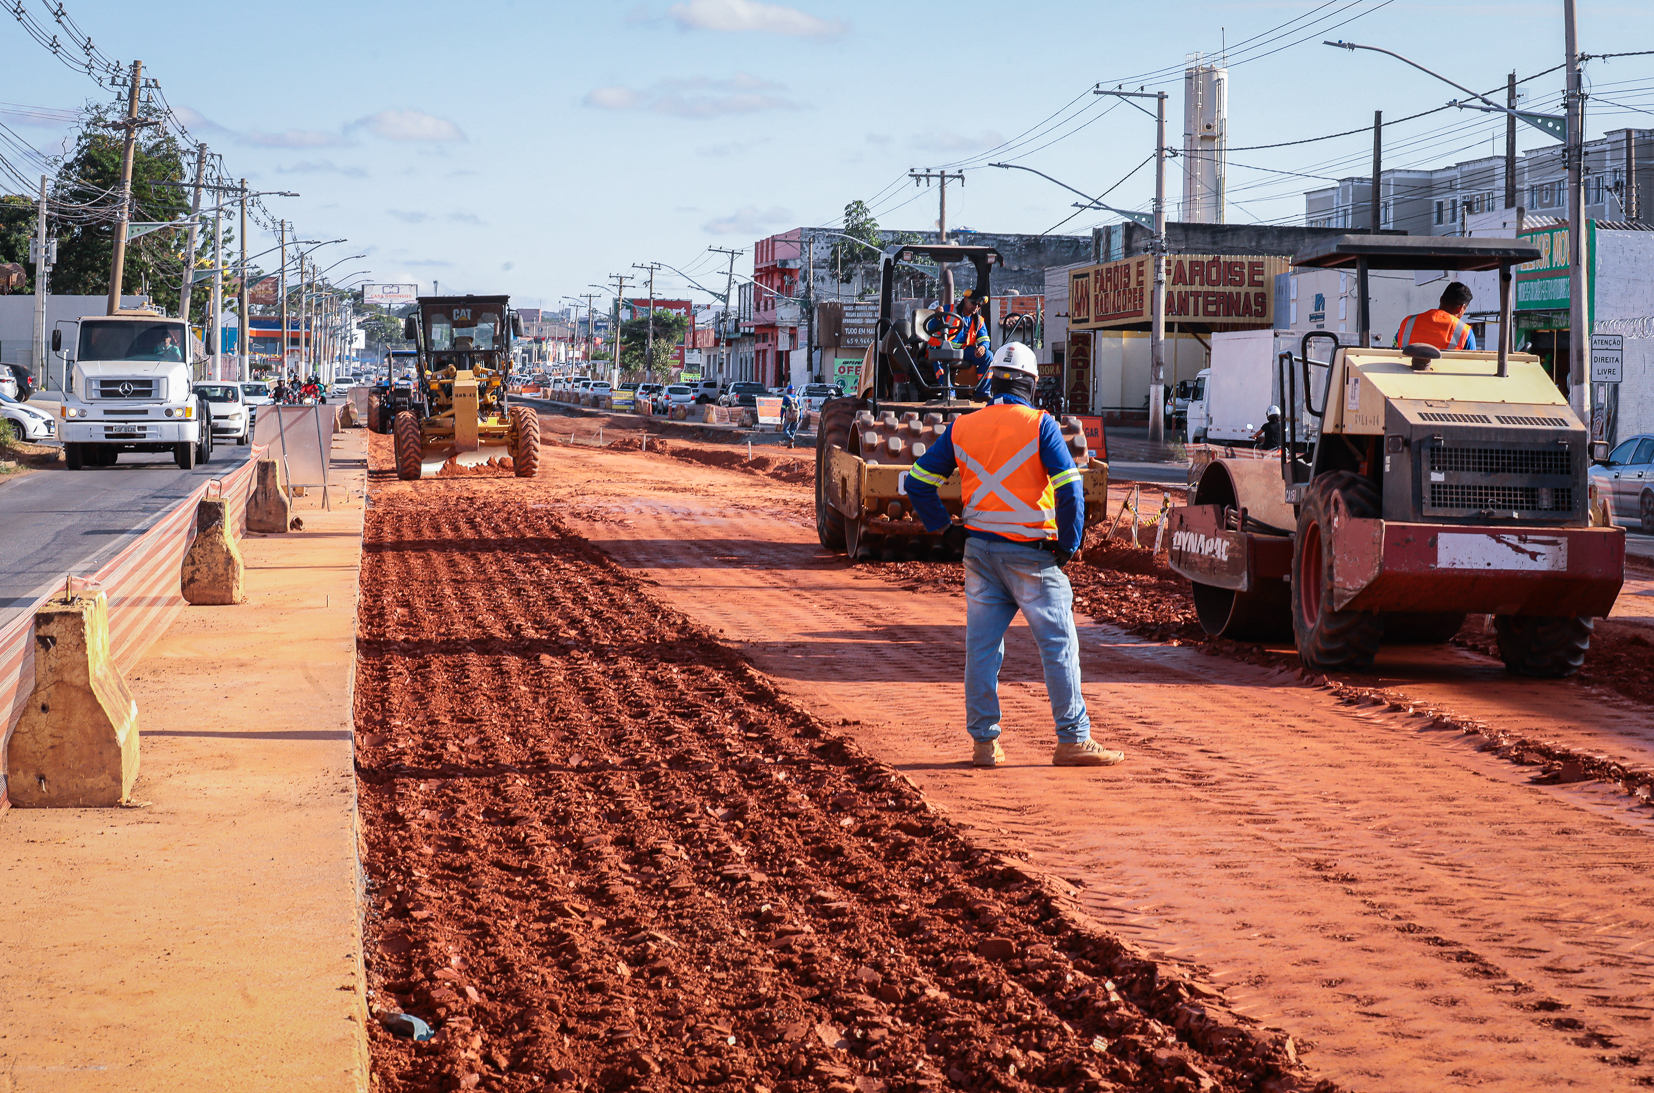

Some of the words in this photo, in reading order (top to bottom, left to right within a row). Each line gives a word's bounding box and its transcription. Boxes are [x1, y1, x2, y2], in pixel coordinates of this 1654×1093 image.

[1517, 232, 1551, 271] HOR
[1151, 290, 1267, 318] ANTERNAS
[452, 308, 472, 321] CAT
[844, 327, 857, 335] TUDO
[1593, 338, 1621, 346] ATENÇÃO
[1593, 356, 1620, 364] DIREITA
[1597, 368, 1617, 376] LIVRE
[1172, 530, 1230, 562] DYNAPAC
